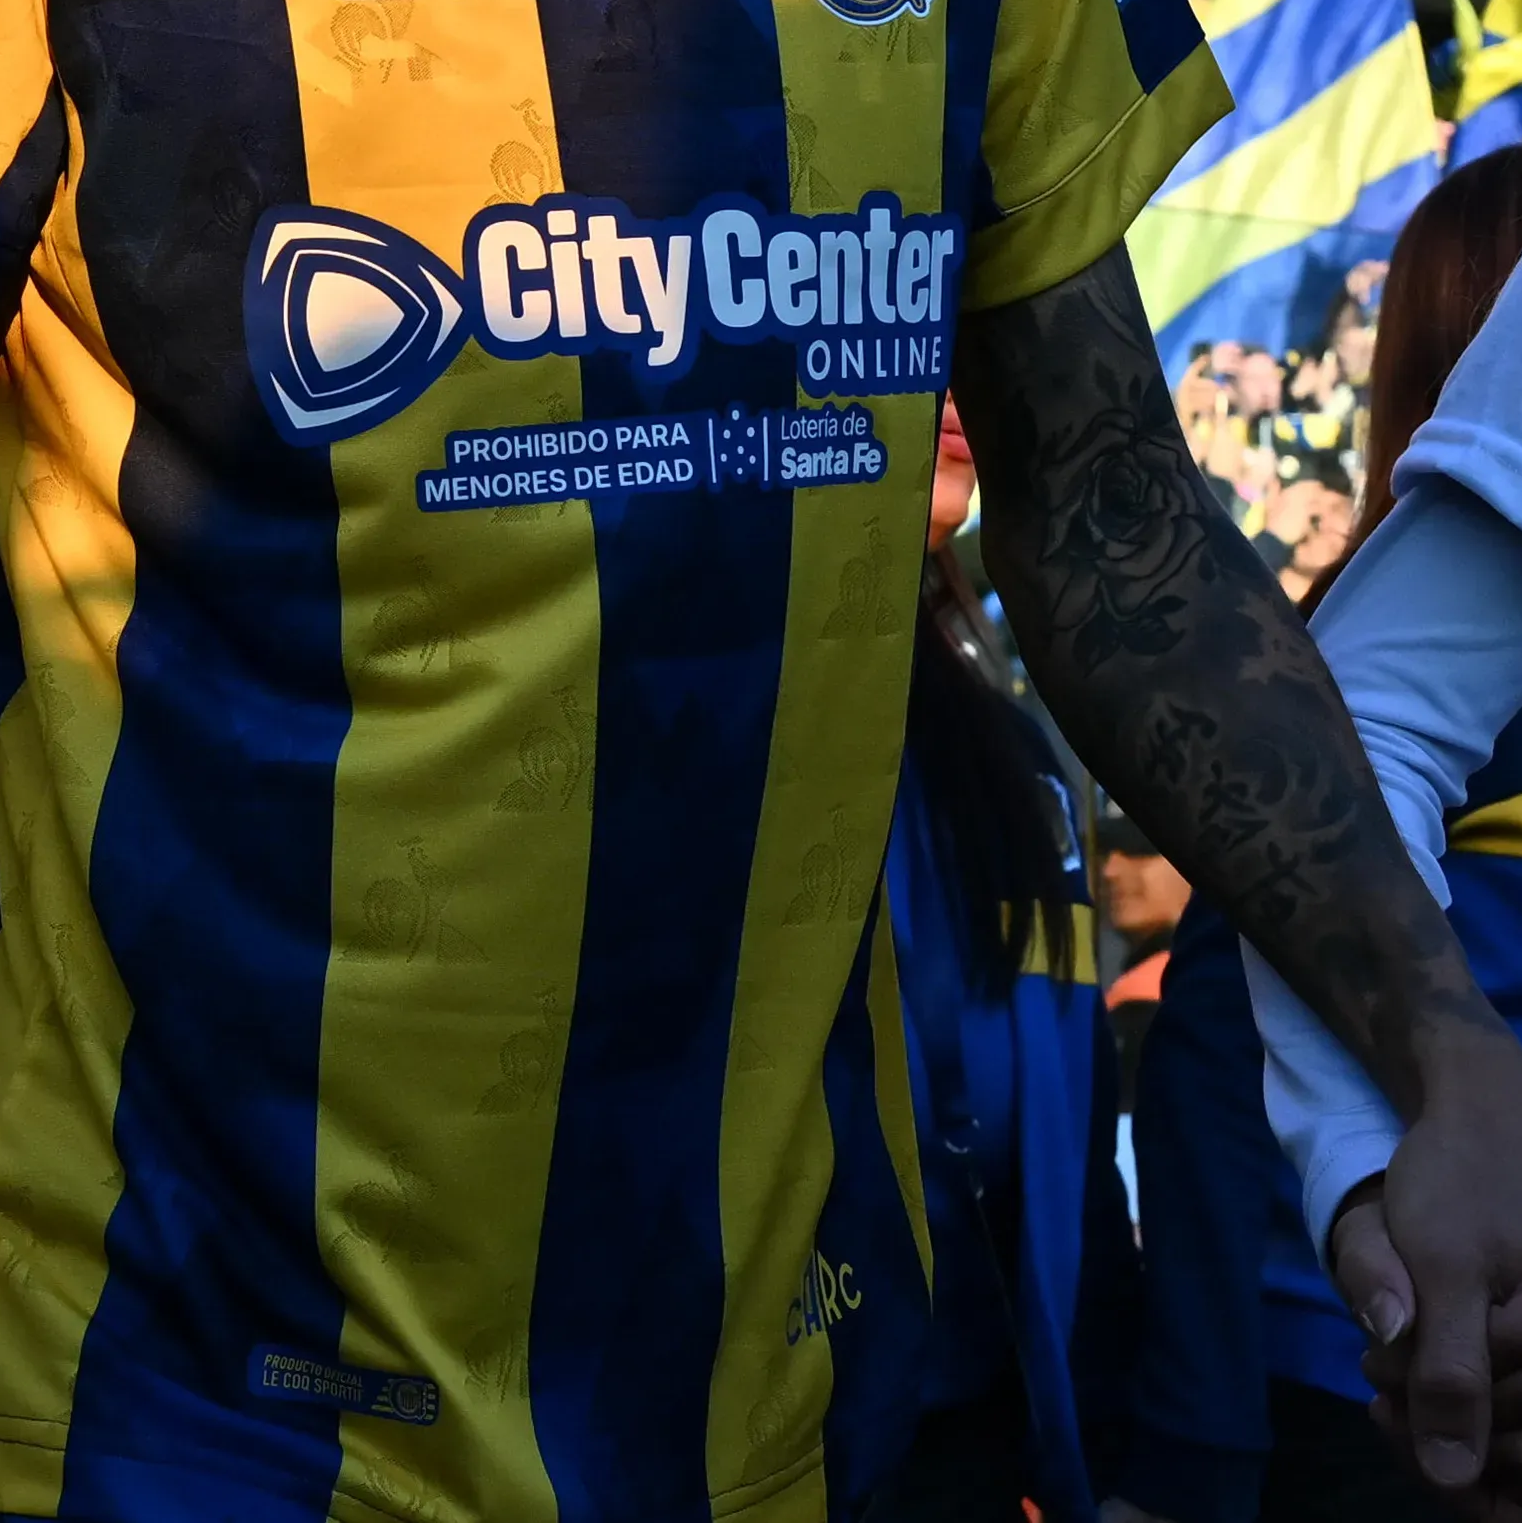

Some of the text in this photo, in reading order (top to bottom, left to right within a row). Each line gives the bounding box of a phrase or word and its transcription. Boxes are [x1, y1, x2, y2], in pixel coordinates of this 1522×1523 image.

[478, 208, 954, 366] City Center
[806, 335, 942, 380] ONLINE
[453, 421, 691, 464] PROHIBIDO PARA
[781, 410, 868, 441] Lotería de
[423, 457, 694, 503] MENORES DE EDAD
[781, 442, 882, 480] Santa Fe
[263, 1353, 322, 1377] PRODUCTO
[263, 1369, 279, 1387] LE
[282, 1372, 310, 1391] COQ
